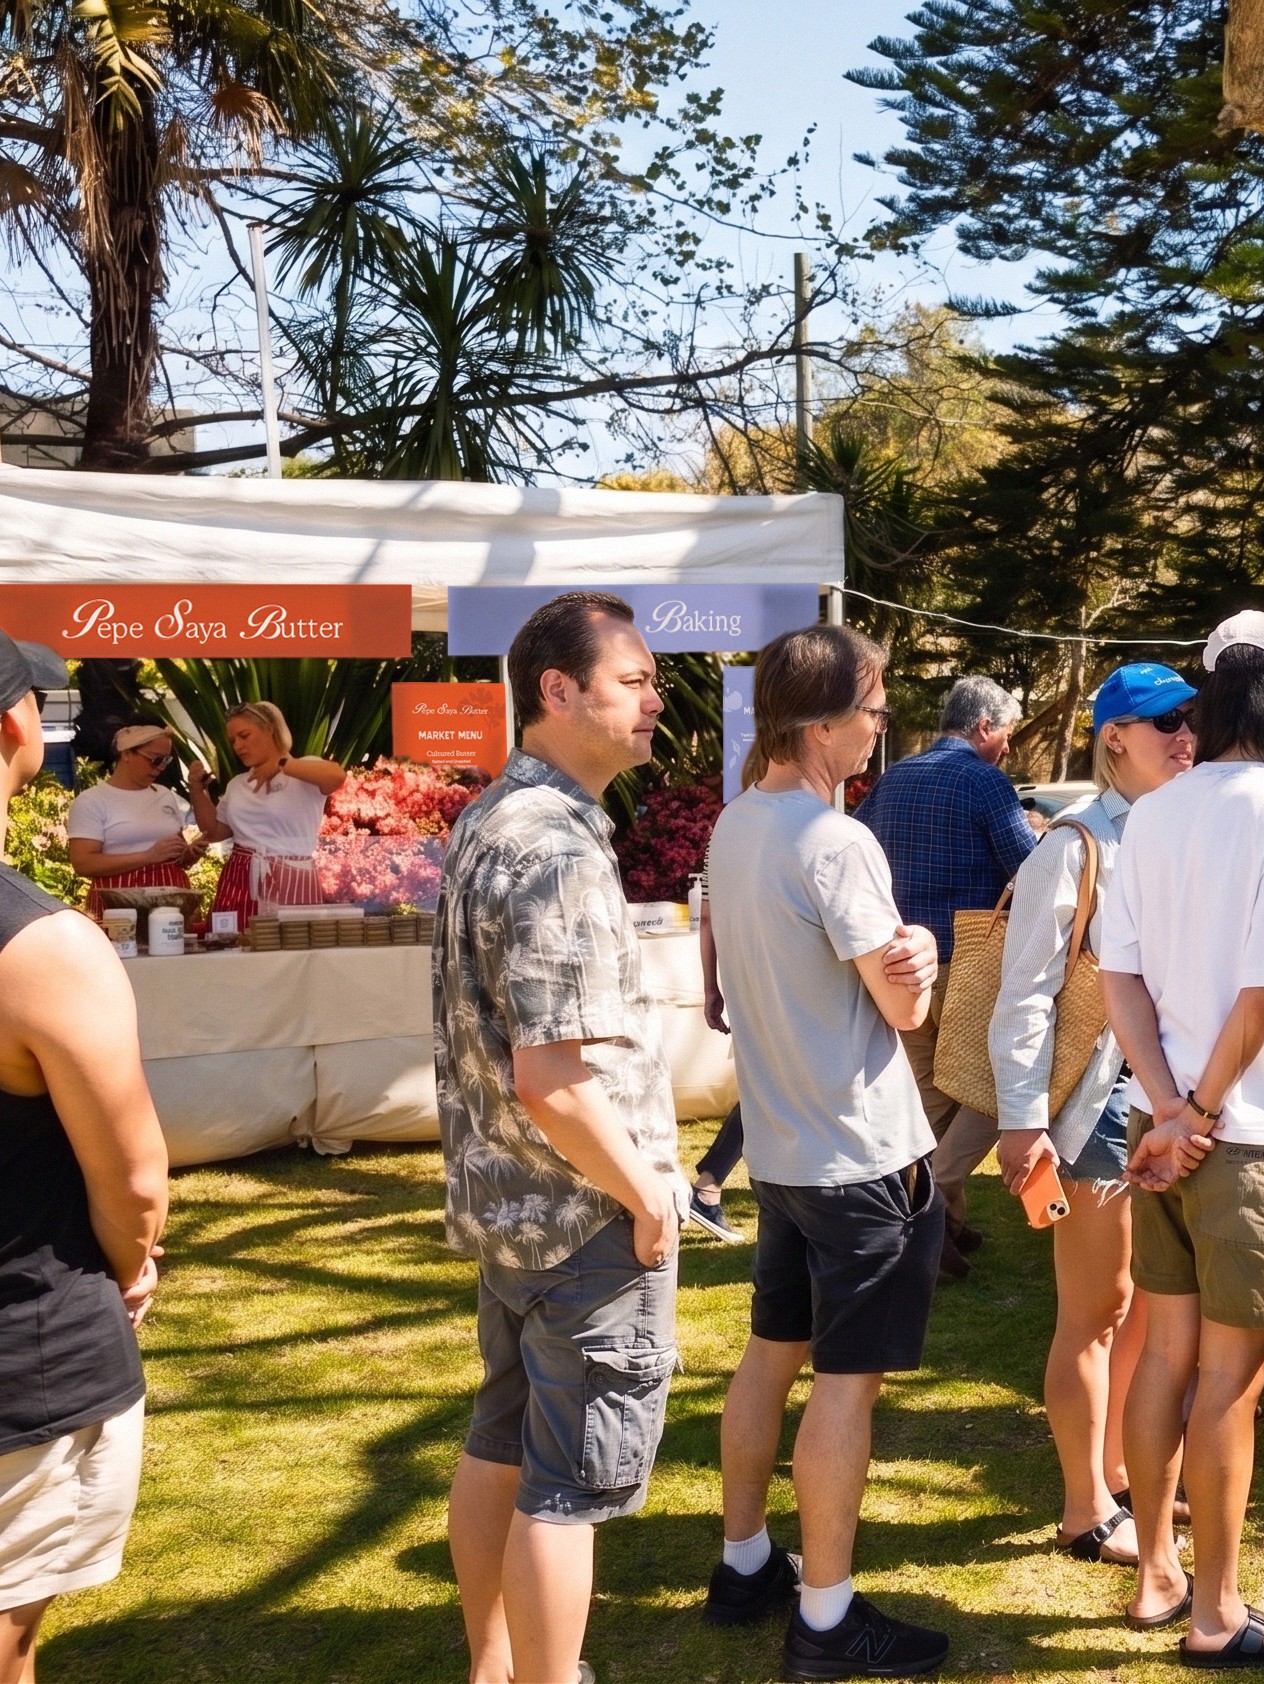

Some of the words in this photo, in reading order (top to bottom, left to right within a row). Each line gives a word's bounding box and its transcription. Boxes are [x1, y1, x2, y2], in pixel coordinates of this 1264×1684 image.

[61, 599, 144, 645] Pepe
[154, 599, 227, 644] Saya
[239, 604, 344, 640] Butter
[645, 600, 742, 636] Baking
[412, 703, 435, 715] Pepe
[437, 703, 457, 715] Saya
[460, 705, 488, 715] Butter
[418, 731, 455, 740] MARKET
[458, 731, 483, 740] MENU
